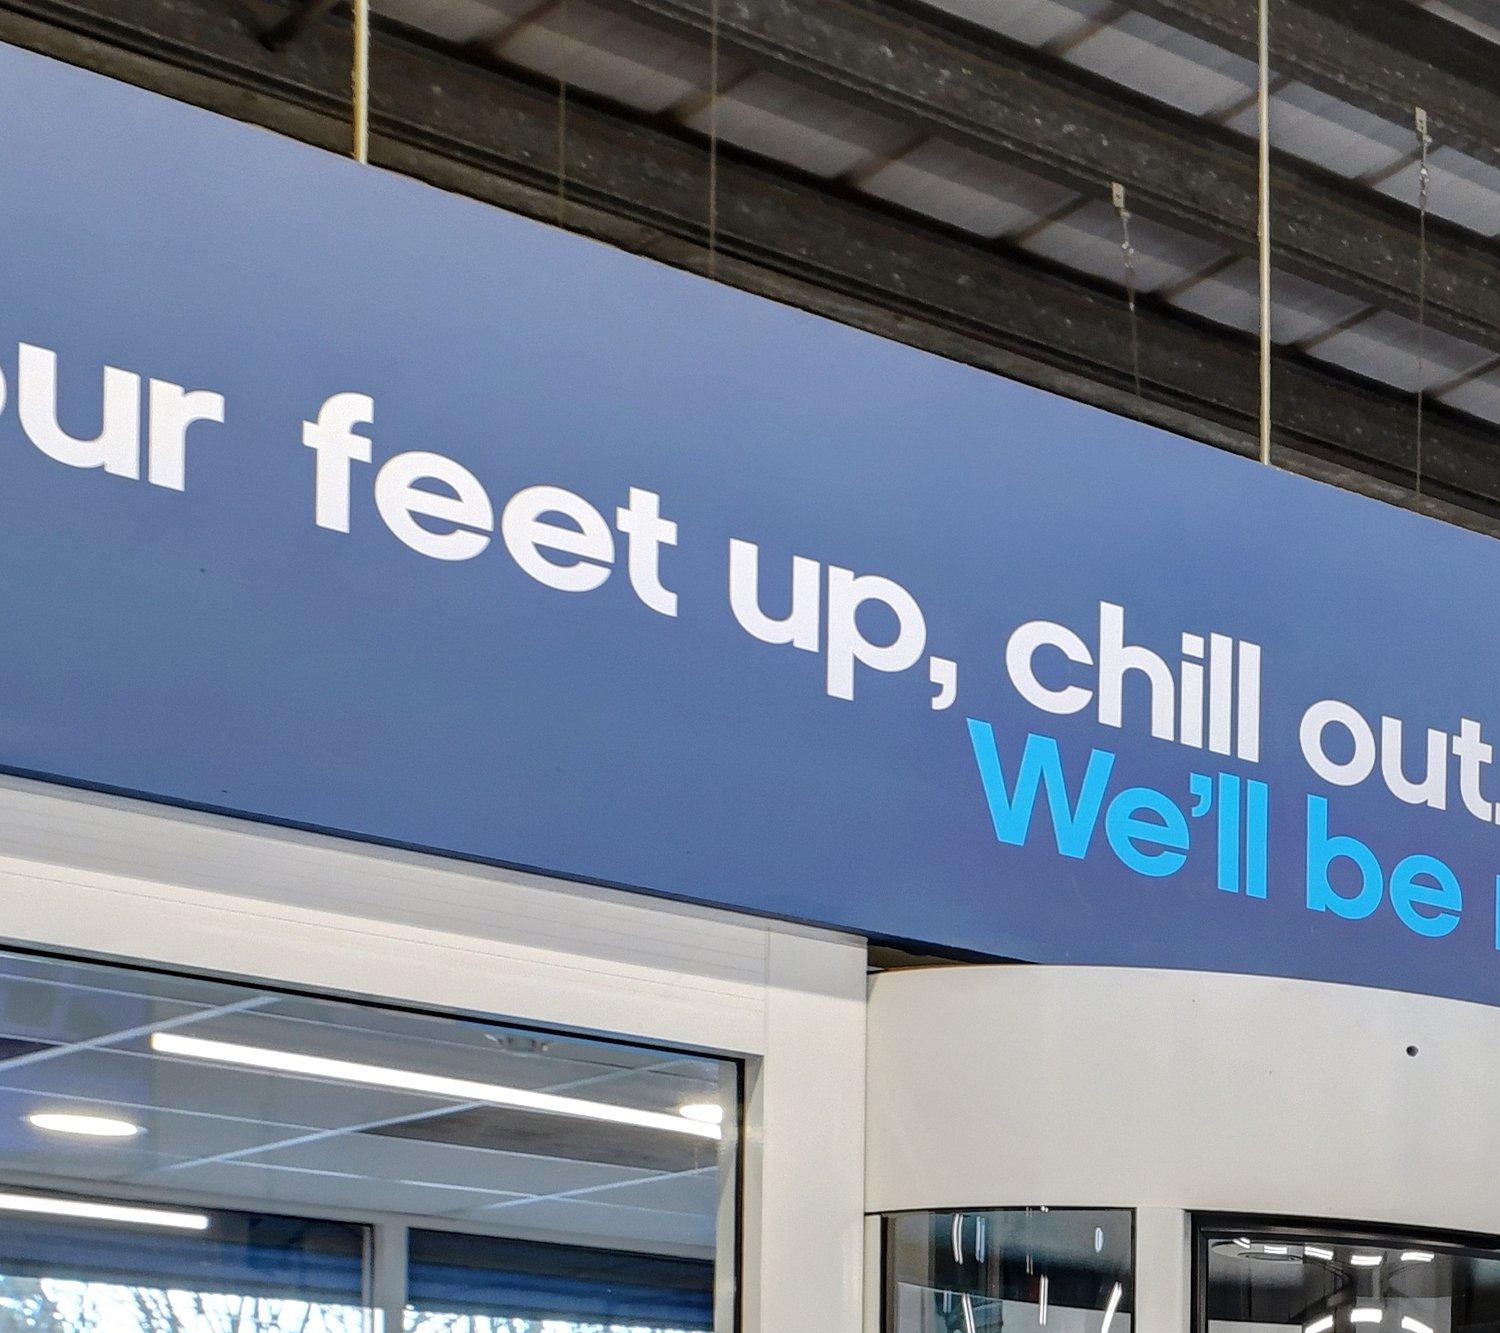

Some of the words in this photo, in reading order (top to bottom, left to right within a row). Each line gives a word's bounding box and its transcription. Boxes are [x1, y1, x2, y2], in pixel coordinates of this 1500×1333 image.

[0, 342, 225, 492] ur
[303, 393, 679, 618] feet
[728, 537, 959, 711] up,
[1005, 601, 1261, 763] chill
[967, 717, 1268, 899] We'll
[1306, 797, 1462, 938] be
